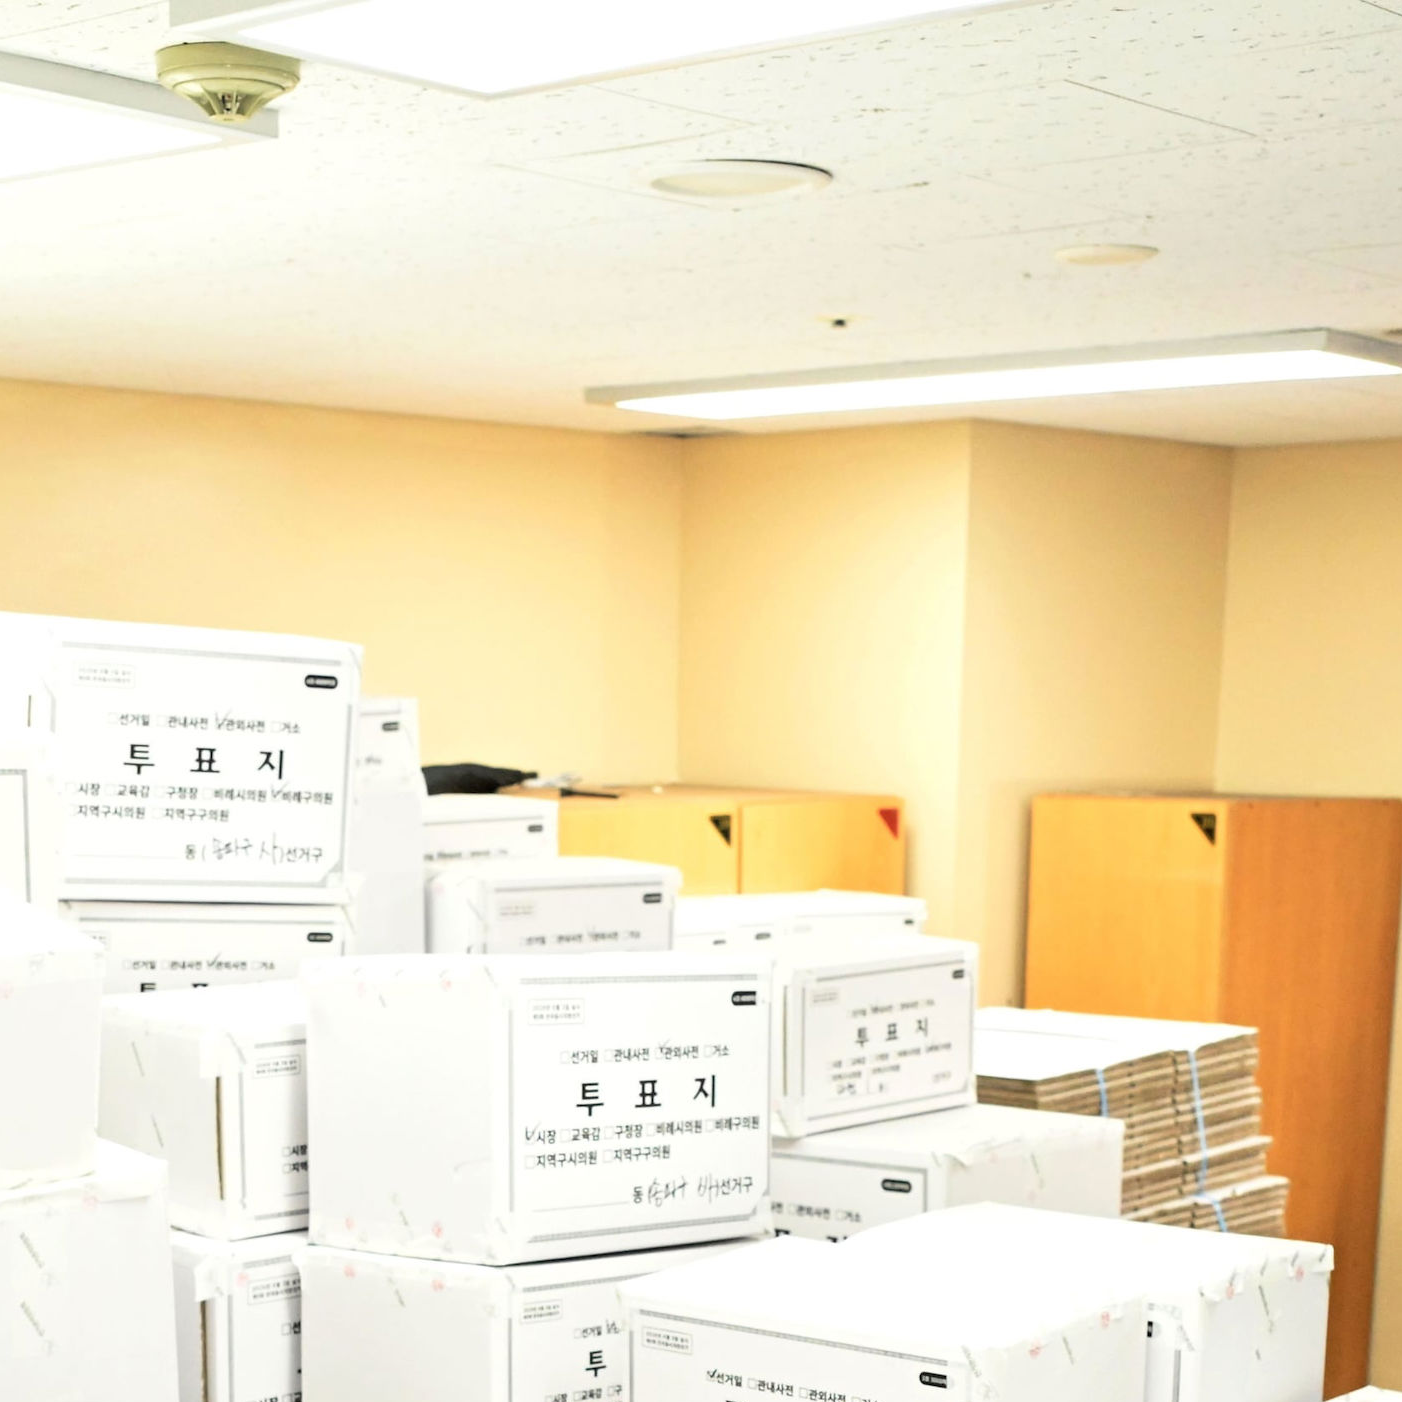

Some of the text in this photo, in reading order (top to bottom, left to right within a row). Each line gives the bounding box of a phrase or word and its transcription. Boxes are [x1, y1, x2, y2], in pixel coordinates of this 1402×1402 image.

[571, 1050, 599, 1064] 선거일
[614, 1048, 650, 1062] 관내사전
[664, 1046, 699, 1060] 관외사전
[537, 1145, 671, 1168] 지역구시의원 지역구구의원
[716, 1372, 743, 1387] 선거일
[757, 1380, 794, 1396] 관내사전
